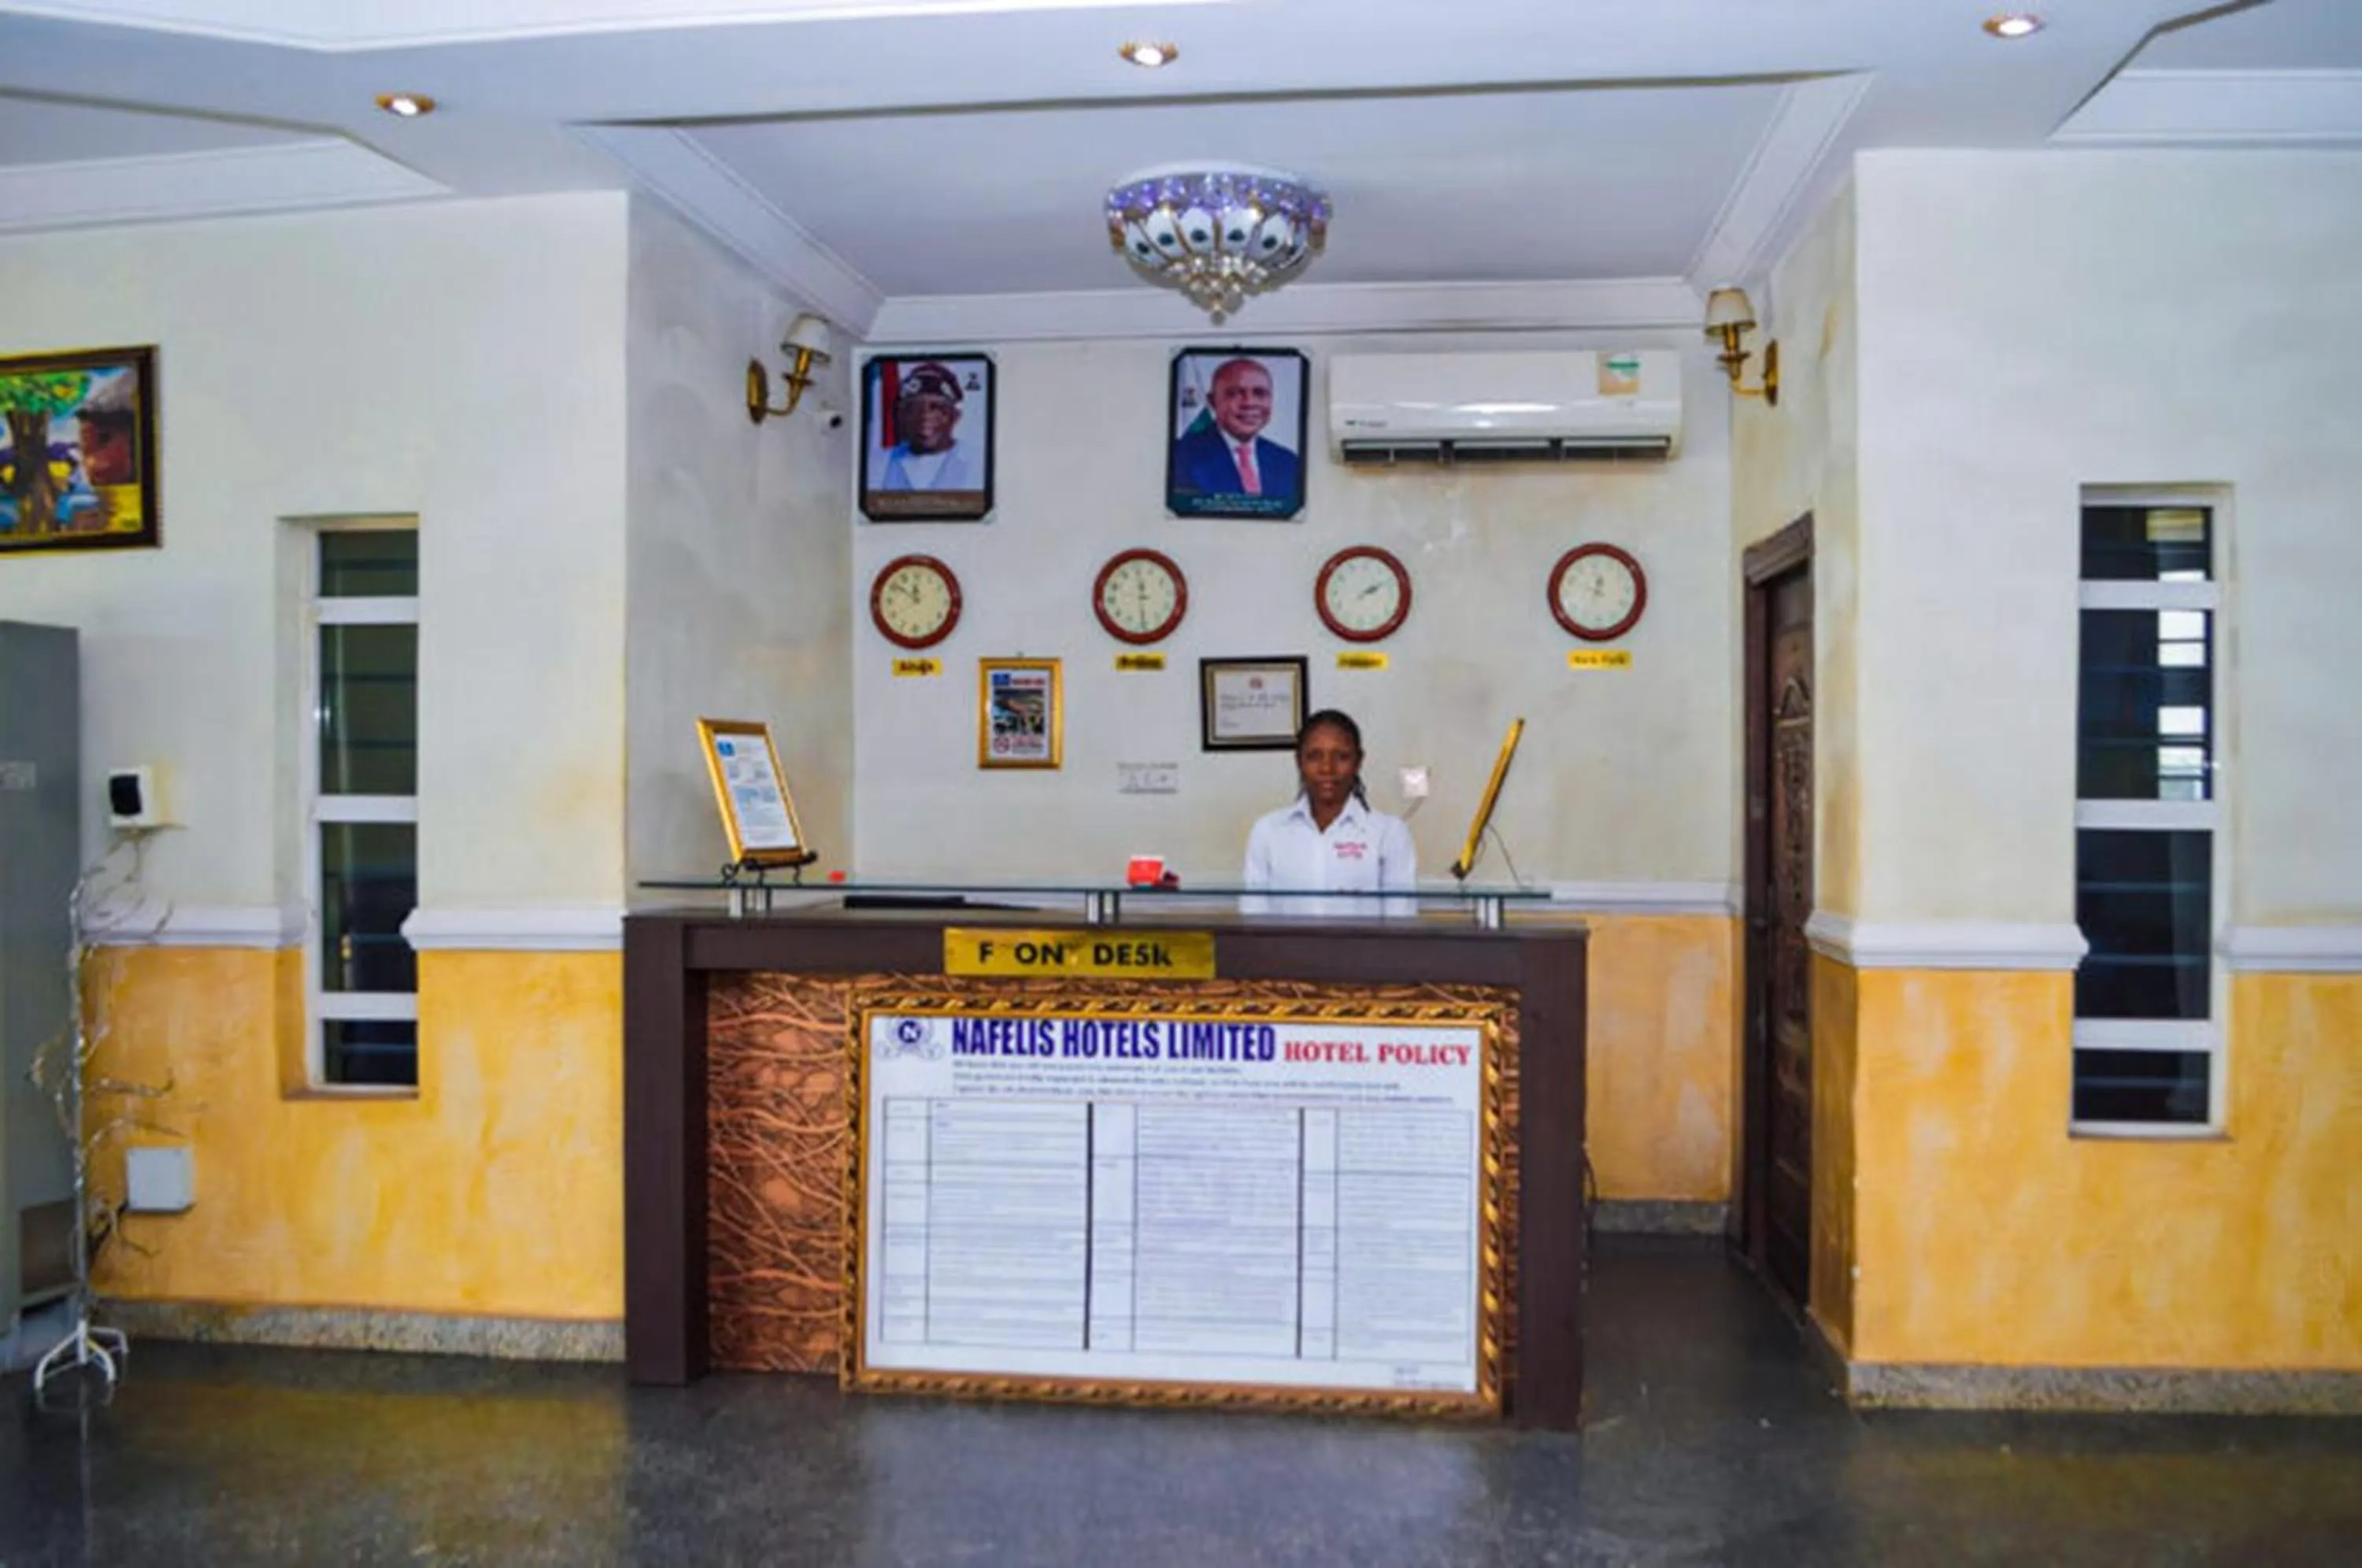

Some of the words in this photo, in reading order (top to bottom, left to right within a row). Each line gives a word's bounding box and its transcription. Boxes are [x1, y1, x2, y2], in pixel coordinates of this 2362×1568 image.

[953, 1019, 1054, 1056] NAFELIS
[1062, 1020, 1160, 1059] HOTELS
[1168, 1023, 1275, 1061] LIMITED
[1283, 1040, 1370, 1063] HOTEL
[1379, 1043, 1472, 1066] POLICY
